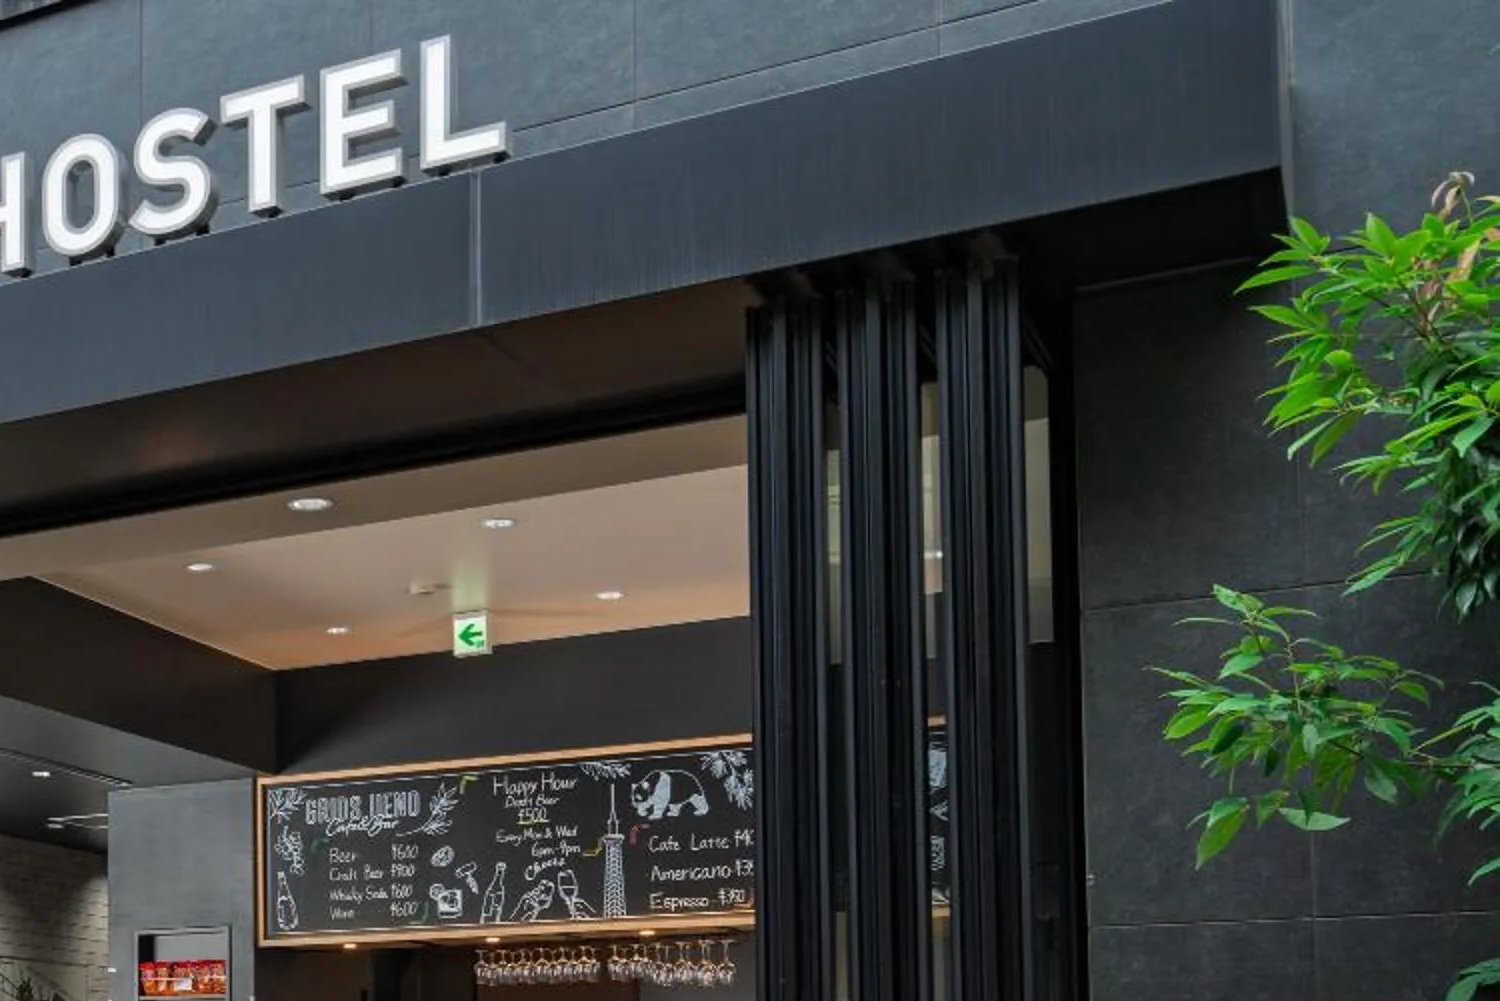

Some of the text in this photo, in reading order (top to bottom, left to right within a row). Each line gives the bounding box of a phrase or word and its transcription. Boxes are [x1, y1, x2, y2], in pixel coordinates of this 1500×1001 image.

[493, 772, 577, 796] Happy Hour
[690, 832, 730, 851] Latte
[329, 847, 356, 865] Beer
[649, 864, 732, 883] Americano
[649, 892, 709, 913] Espresso
